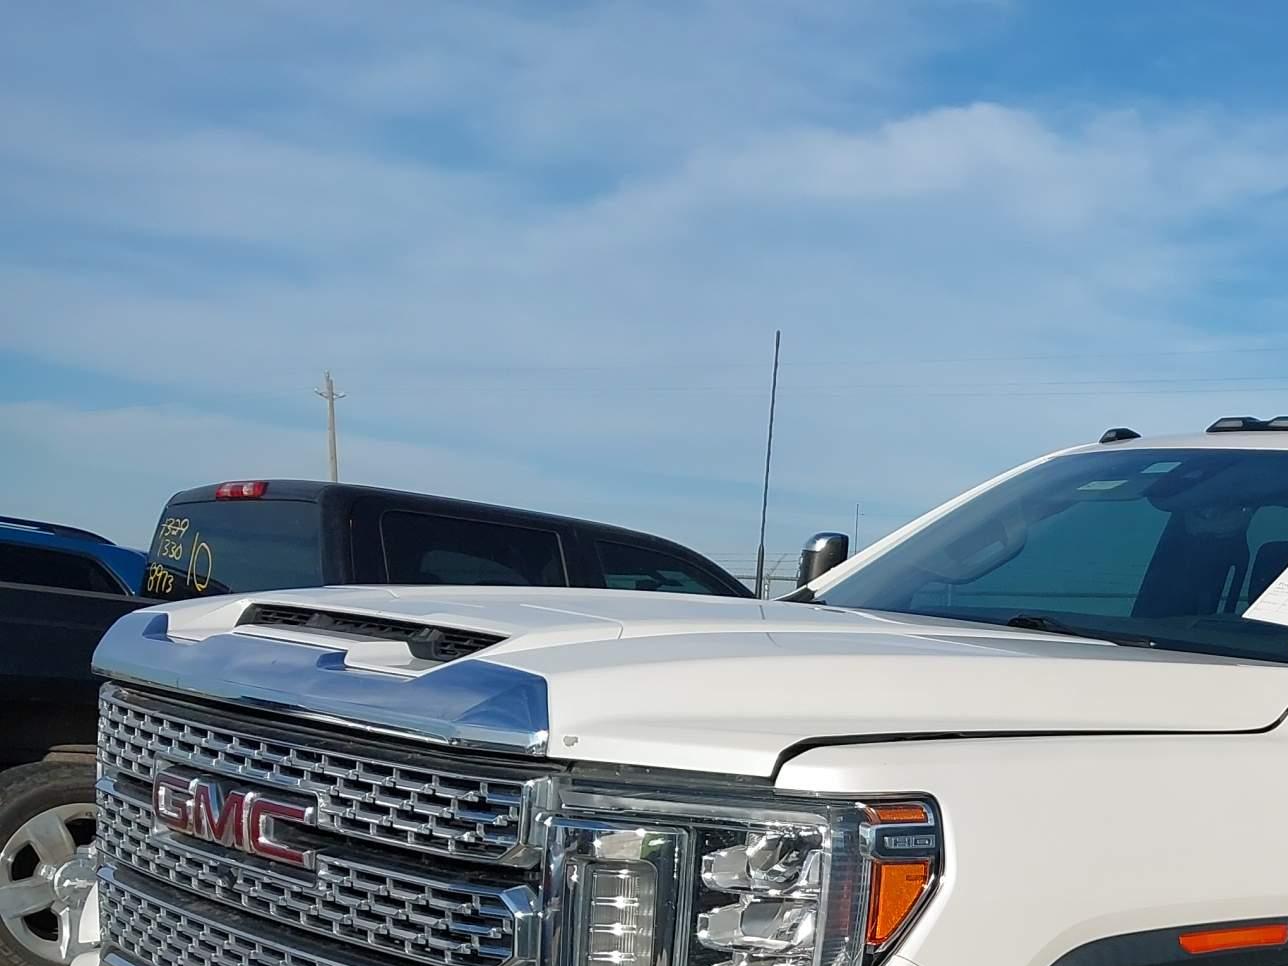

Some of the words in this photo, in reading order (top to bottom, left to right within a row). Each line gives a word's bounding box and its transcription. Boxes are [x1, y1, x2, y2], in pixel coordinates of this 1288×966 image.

[157, 538, 183, 561] 1330
[186, 531, 212, 592] 10
[147, 562, 174, 593] 8973
[153, 771, 319, 872] GMC
